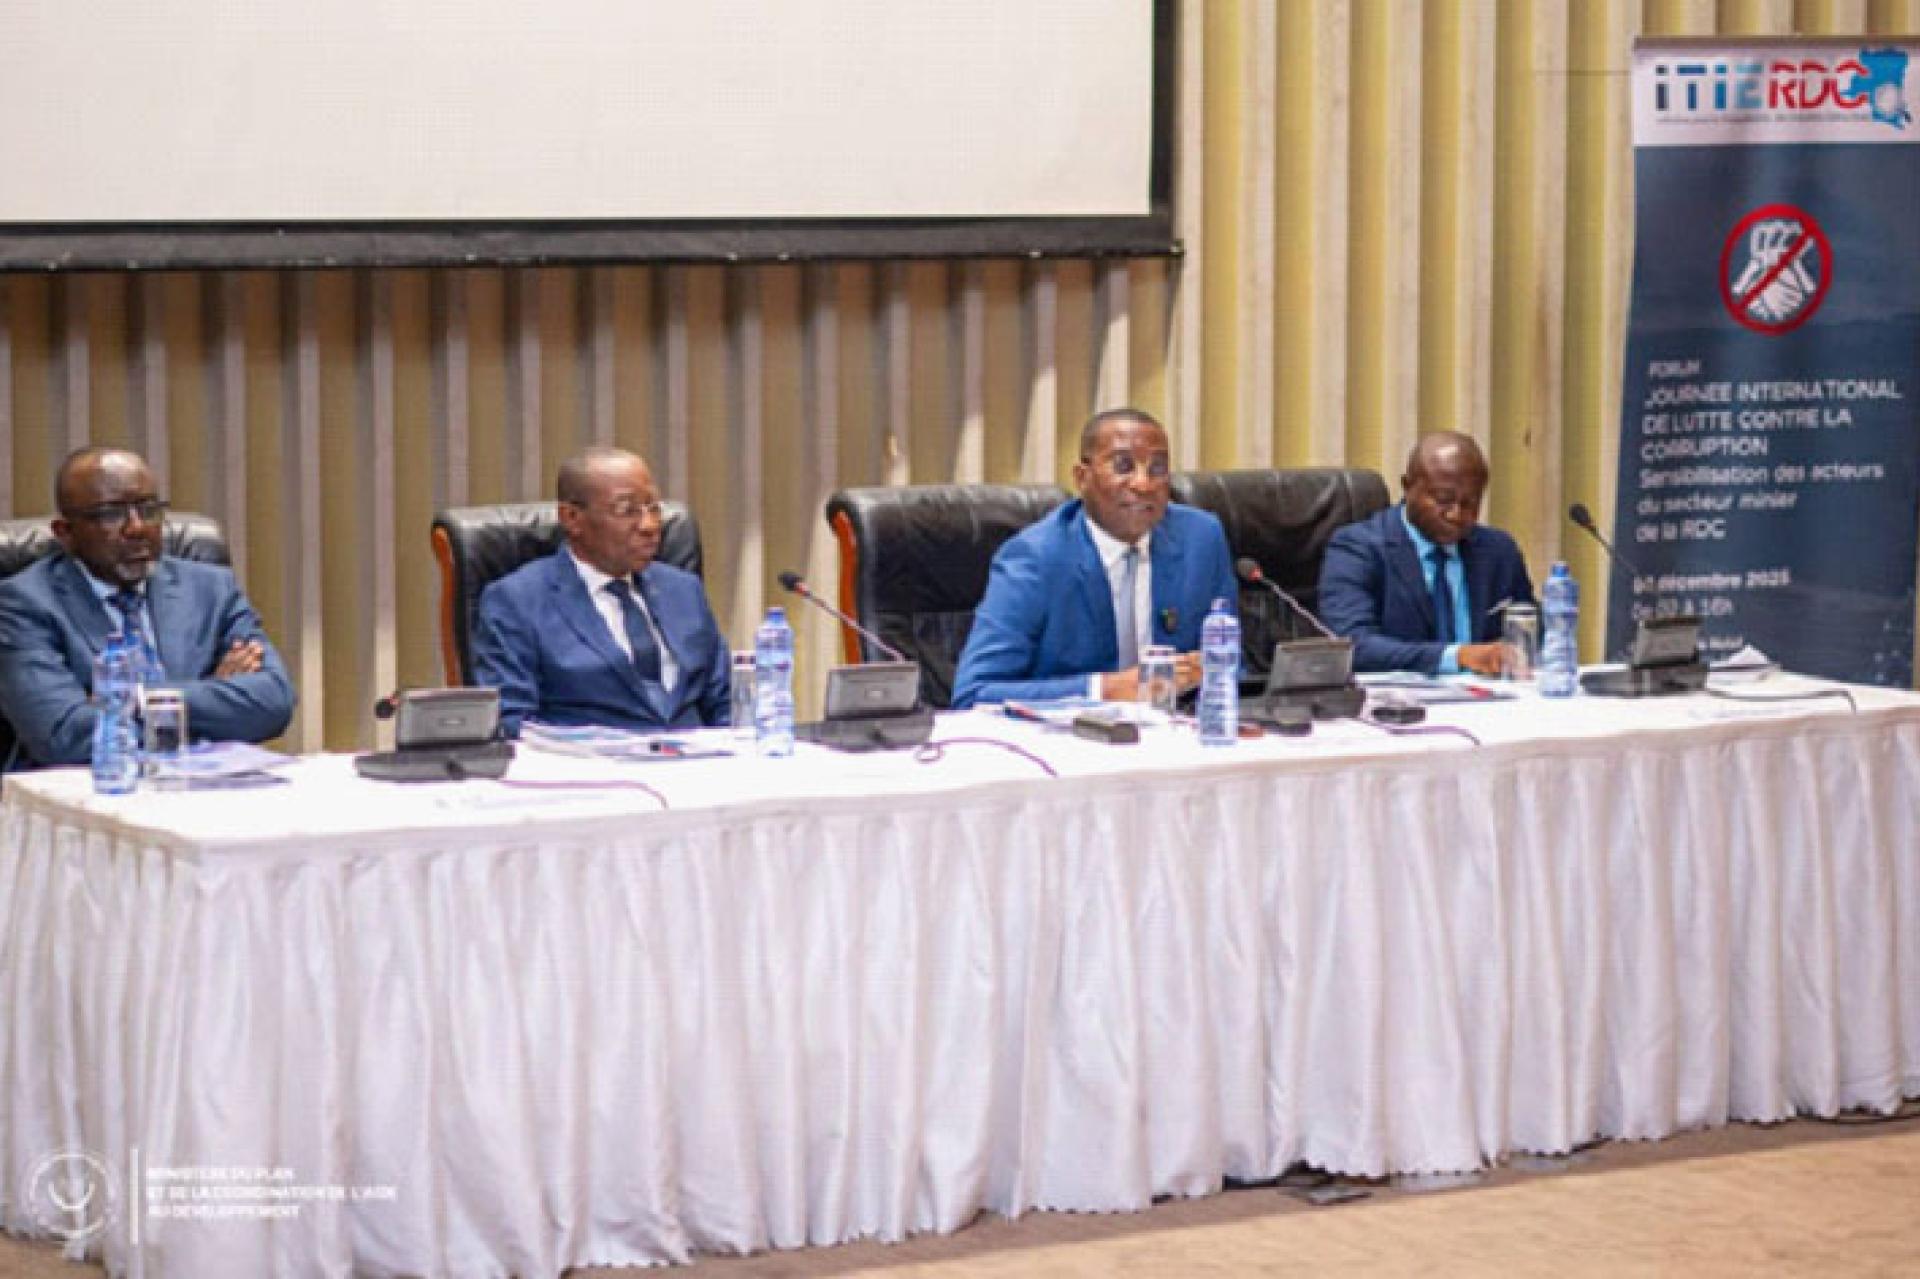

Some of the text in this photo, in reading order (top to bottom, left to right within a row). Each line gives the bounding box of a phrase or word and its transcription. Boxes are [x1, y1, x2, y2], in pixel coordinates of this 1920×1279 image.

[1737, 378, 1902, 401] INTERNATIONAL
[1642, 408, 1852, 434] DE LUTTE CONTRE LA
[1641, 436, 1768, 461] CORRUPTION
[1774, 464, 1805, 483] des
[1811, 462, 1884, 480] acteurs
[1638, 490, 1797, 515] du secteur minier
[1636, 518, 1727, 542] de la RDC
